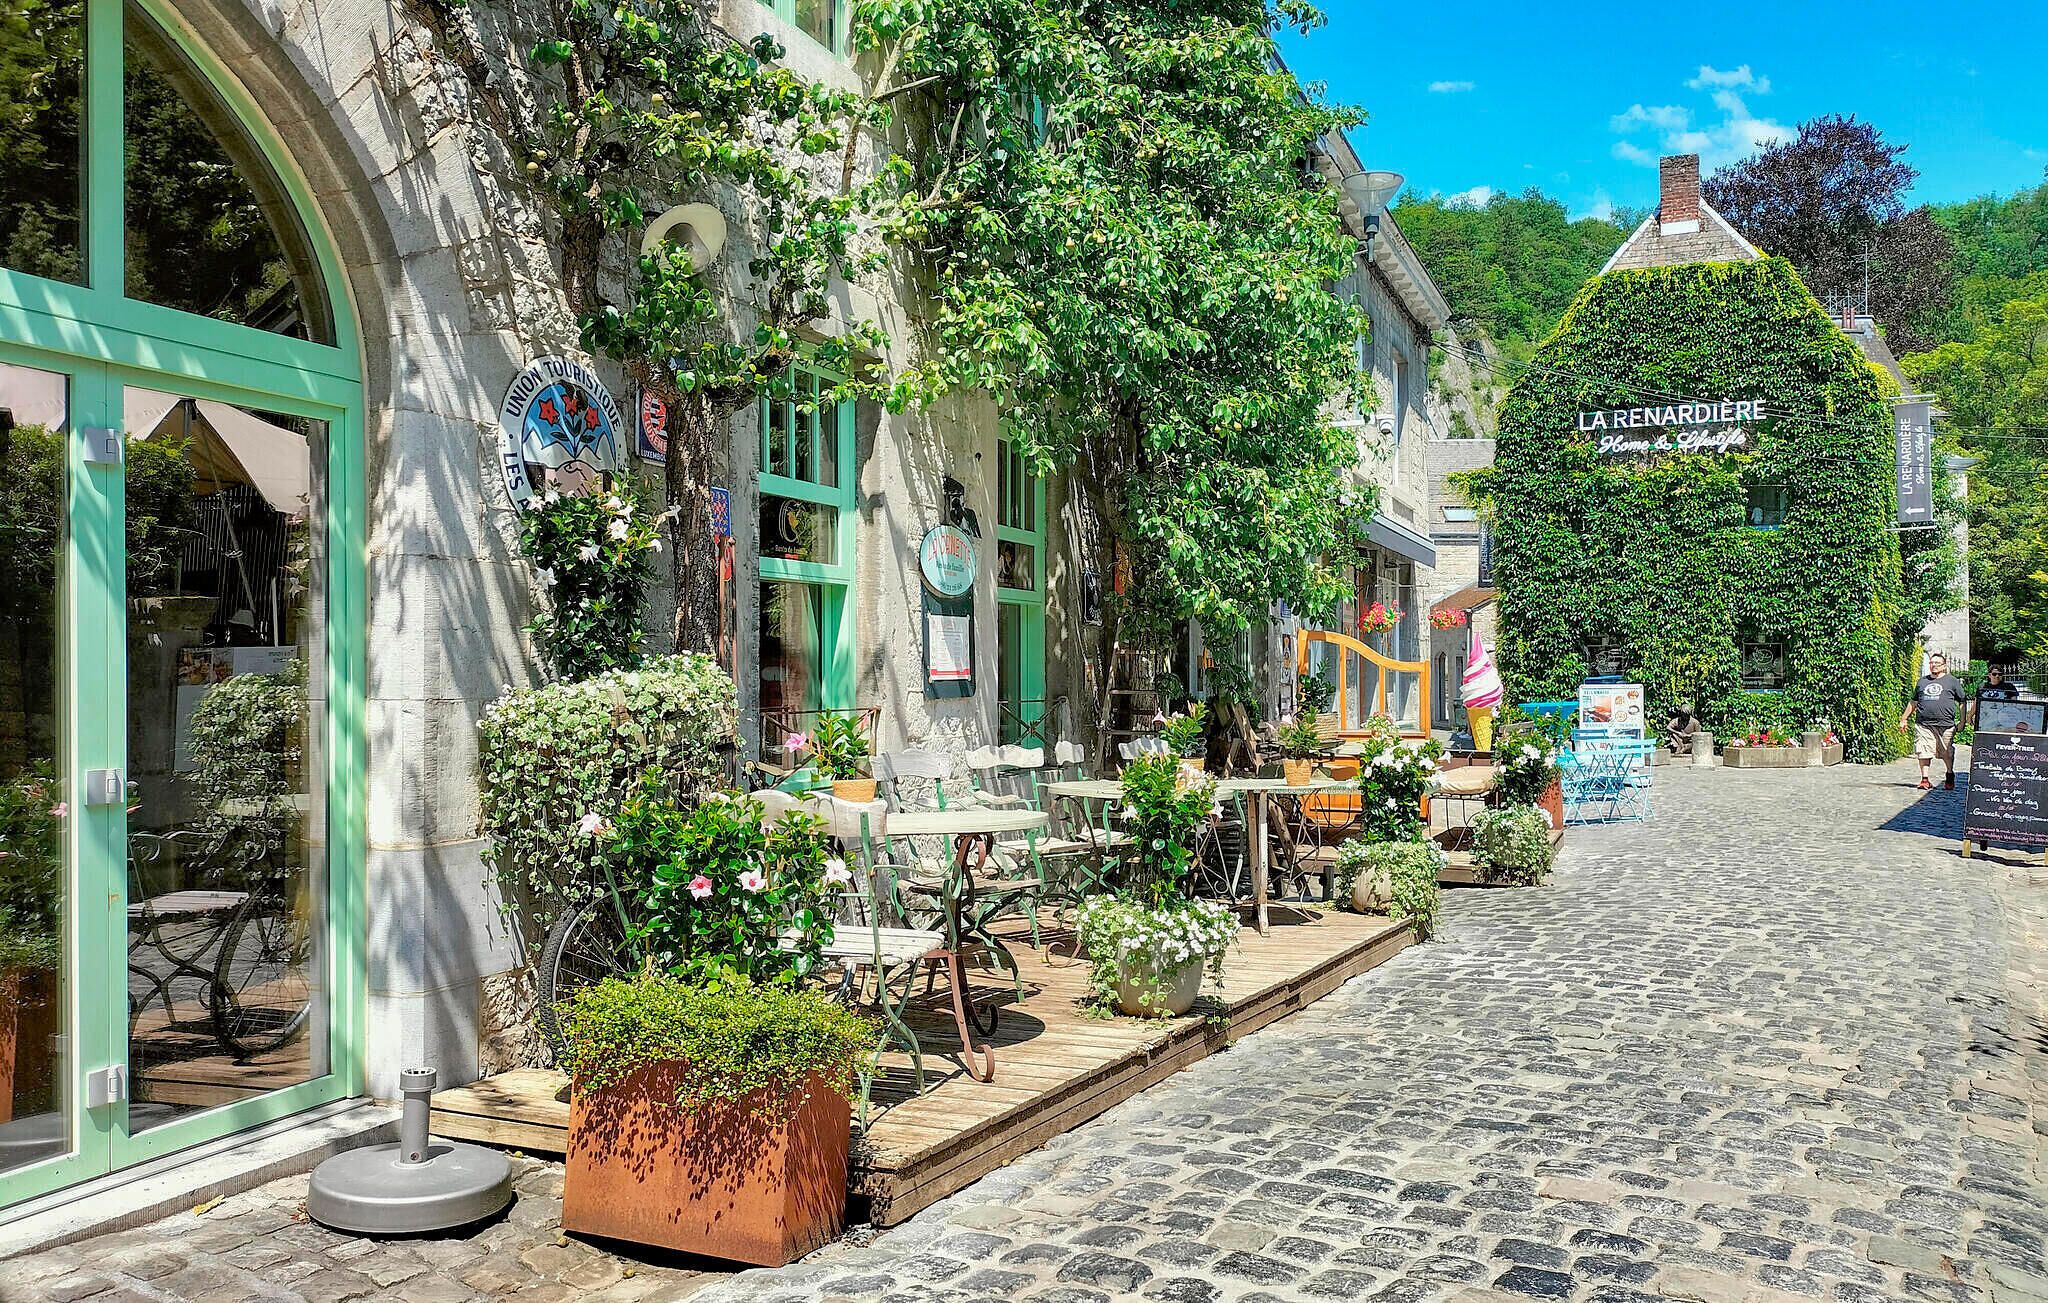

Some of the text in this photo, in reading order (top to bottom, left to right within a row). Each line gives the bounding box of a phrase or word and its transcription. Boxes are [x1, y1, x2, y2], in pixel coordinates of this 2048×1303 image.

[506, 361, 622, 432] UNION TOURISTIQUE
[1579, 397, 1767, 431] LA RENARDIÈRE
[1598, 427, 1747, 454] Home & Lifestyle
[1898, 417, 1913, 495] LA RENARDIÈRE
[503, 452, 525, 491] LES
[1916, 463, 1925, 485] Home
[927, 537, 938, 561] LA
[1995, 743, 2035, 752] FEVER-TREE
